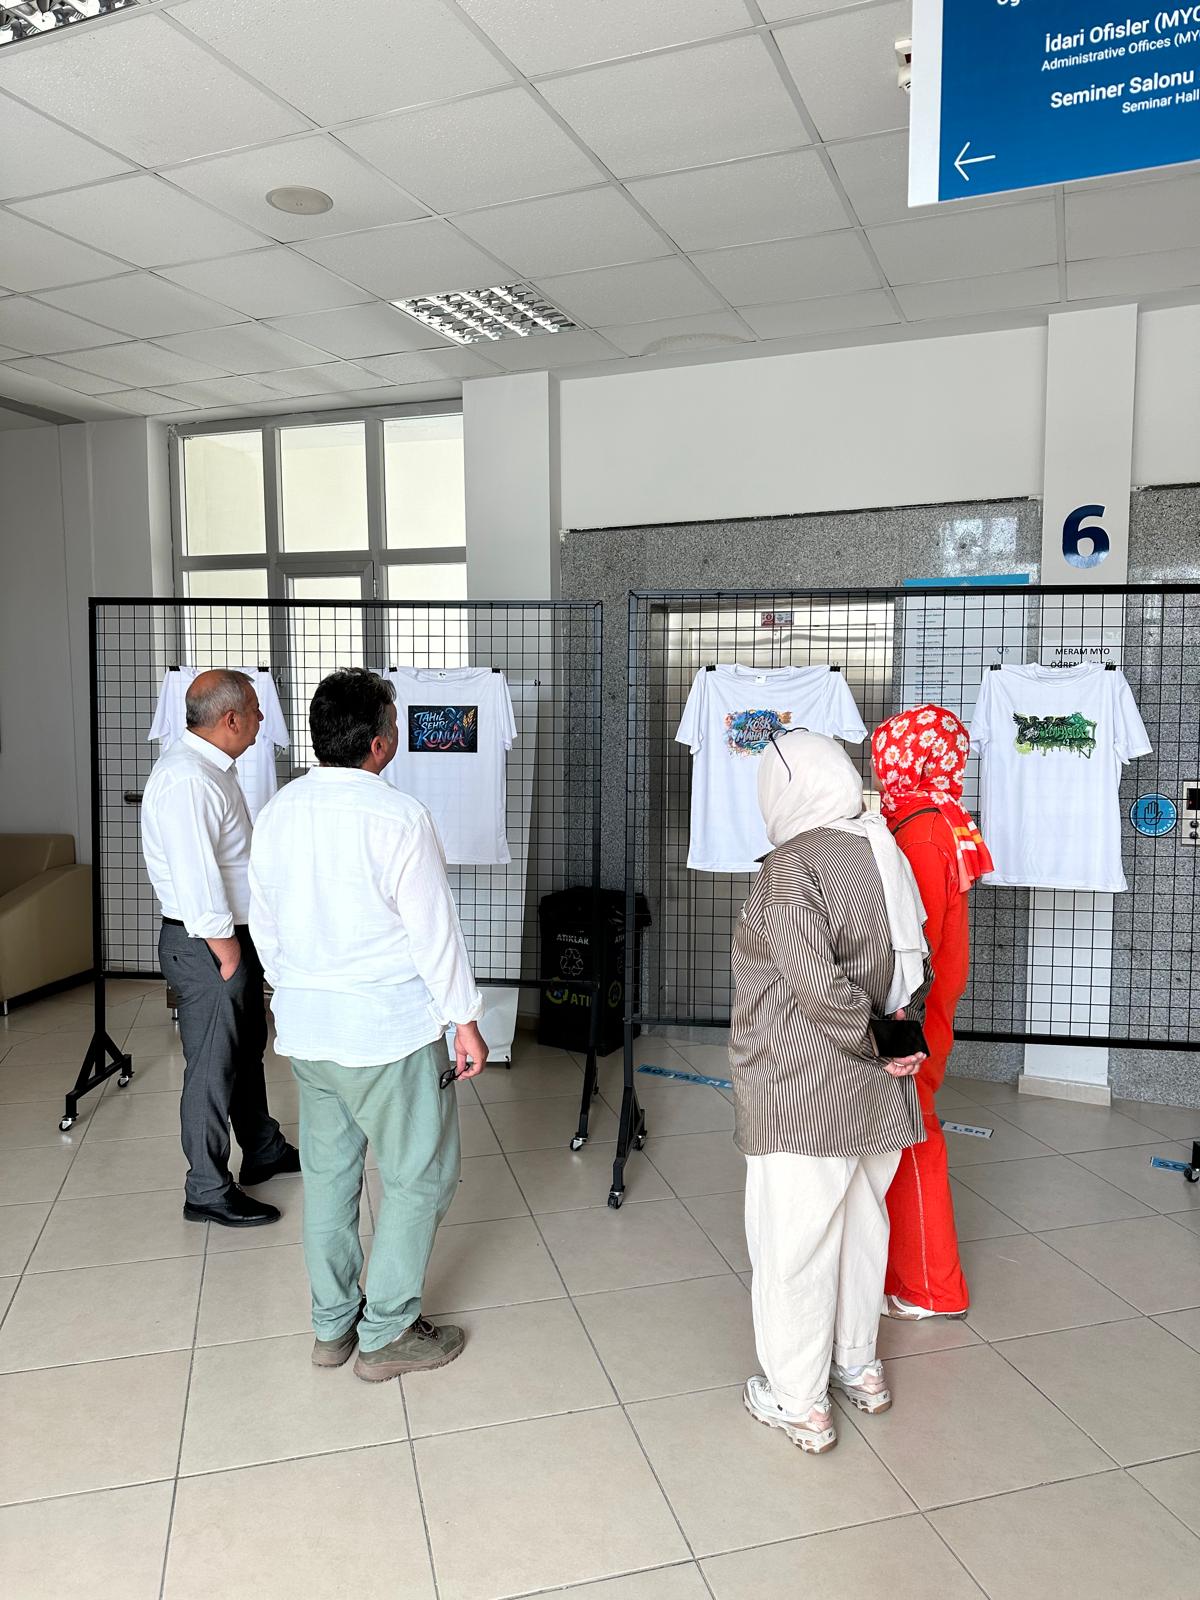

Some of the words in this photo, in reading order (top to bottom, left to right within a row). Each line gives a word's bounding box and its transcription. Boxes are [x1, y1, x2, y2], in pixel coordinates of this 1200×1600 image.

[1041, 45, 1126, 72] Administrative
[1128, 36, 1171, 54] Offices
[1174, 29, 1200, 47] (MY
[1045, 29, 1085, 53] İdari
[1089, 18, 1150, 43] Ofisler
[1050, 81, 1125, 109] Seminer
[1129, 70, 1194, 94] Salonu
[1122, 95, 1173, 114] Seminar
[1175, 88, 1200, 104] Hall
[1062, 504, 1110, 569] 6
[570, 993, 592, 1007] ATI
[951, 1125, 986, 1135] 1.5M
